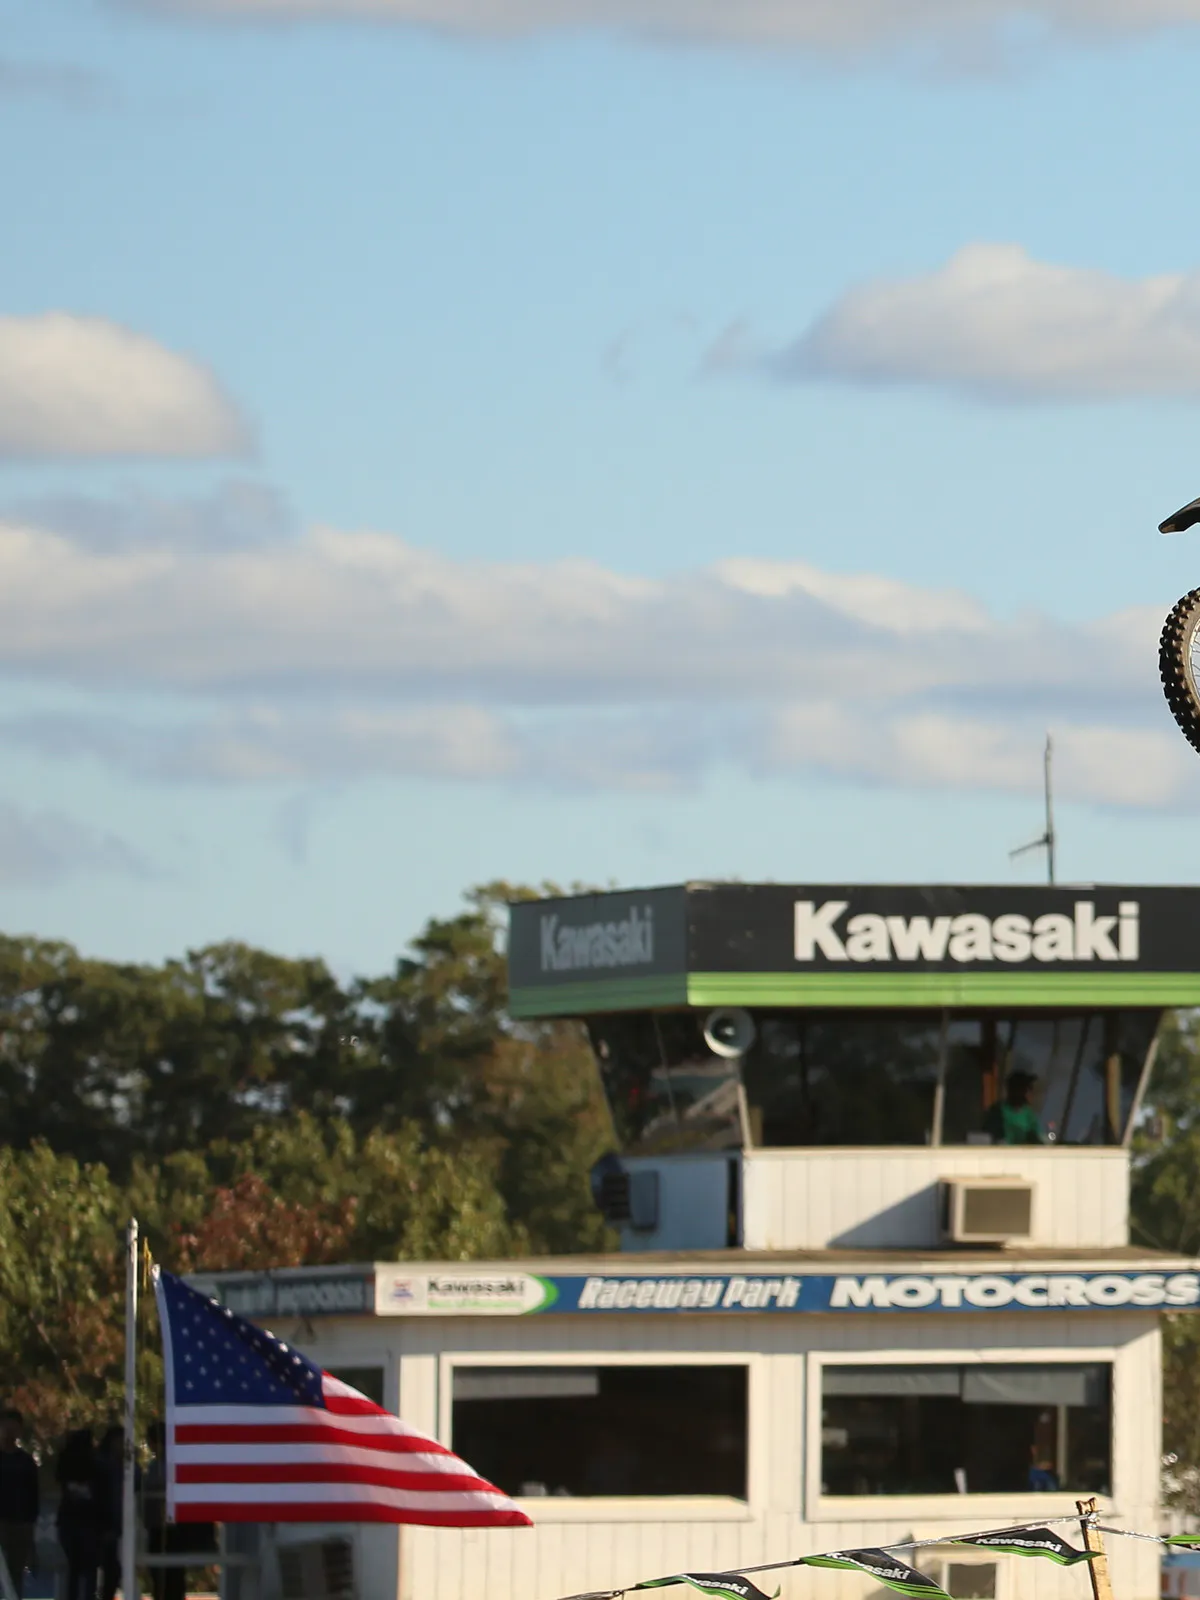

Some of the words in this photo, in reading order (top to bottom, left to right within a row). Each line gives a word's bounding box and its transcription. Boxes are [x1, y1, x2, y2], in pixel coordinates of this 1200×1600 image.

[540, 905, 653, 971] Kawasaki
[794, 900, 1139, 962] Kawasaki
[578, 1277, 724, 1309] Raceway
[721, 1276, 802, 1308] Park
[829, 1274, 1200, 1308] MOTOCROSS
